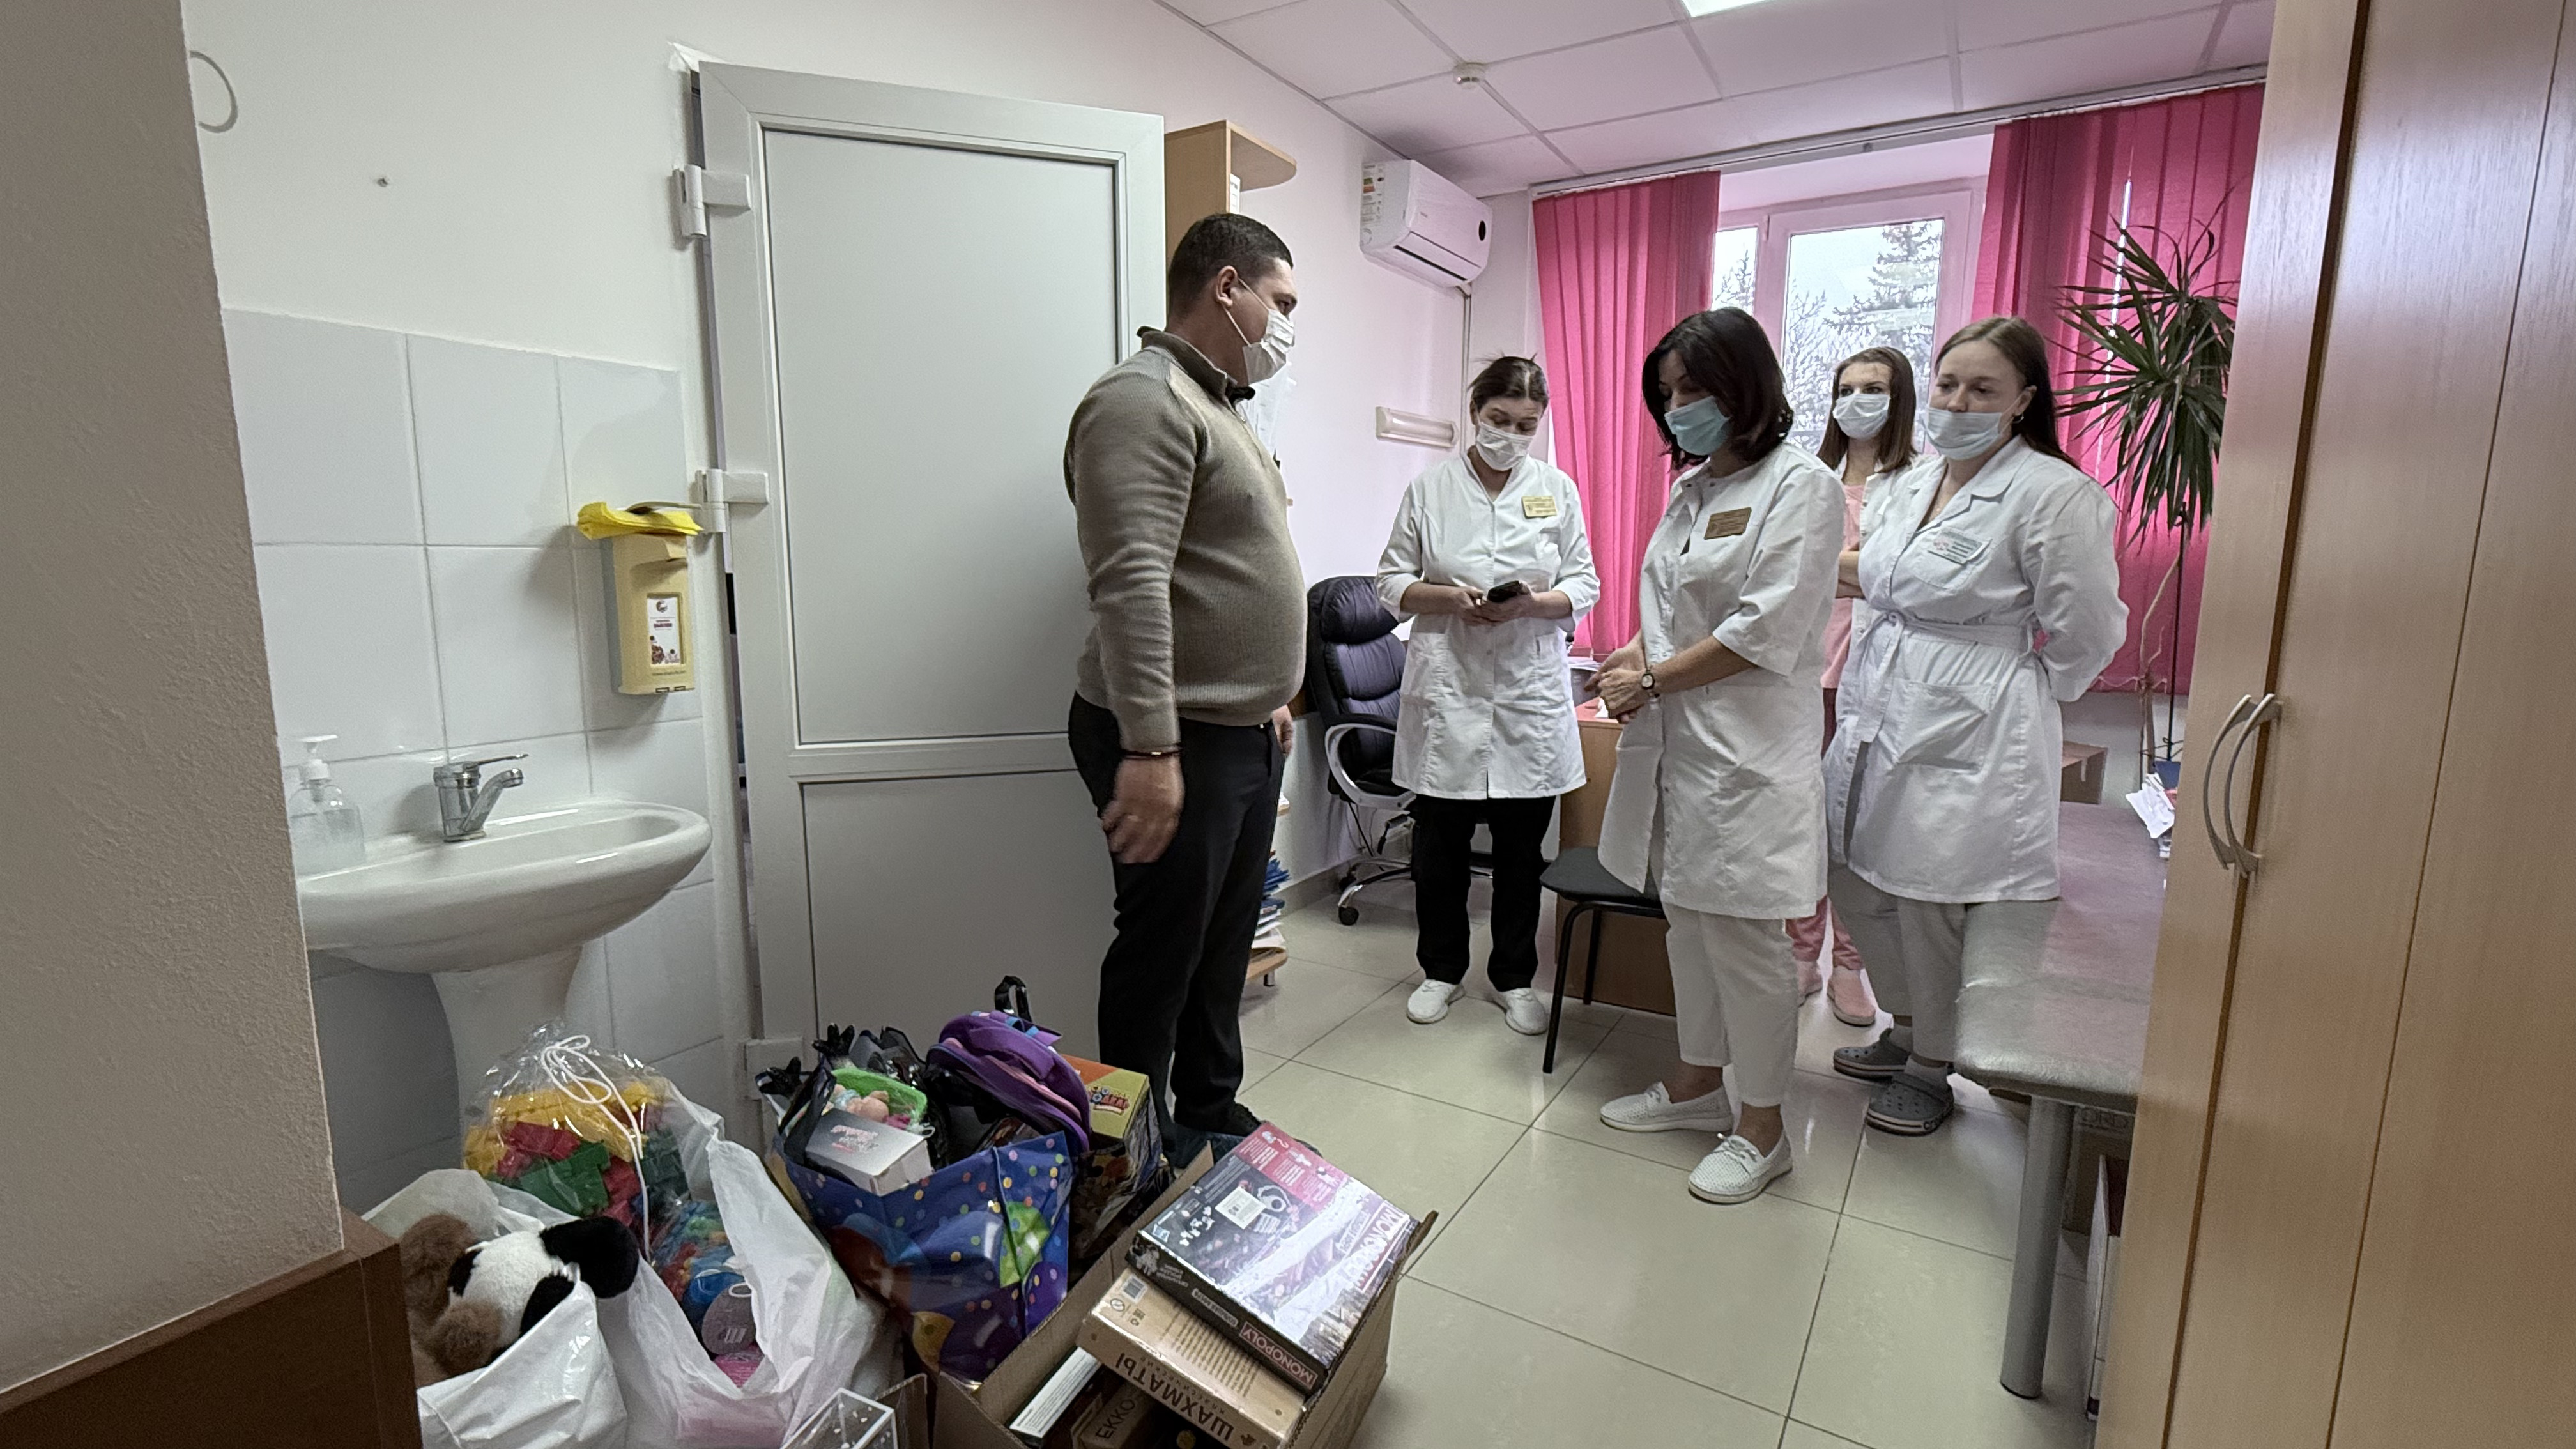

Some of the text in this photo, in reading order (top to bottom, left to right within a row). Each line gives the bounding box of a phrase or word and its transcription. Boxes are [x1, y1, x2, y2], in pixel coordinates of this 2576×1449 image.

[1342, 1207, 1407, 1288] MONO
[1243, 1326, 1315, 1384] MONOPOLY
[1115, 1352, 1235, 1441] ШАХМАТЫ
